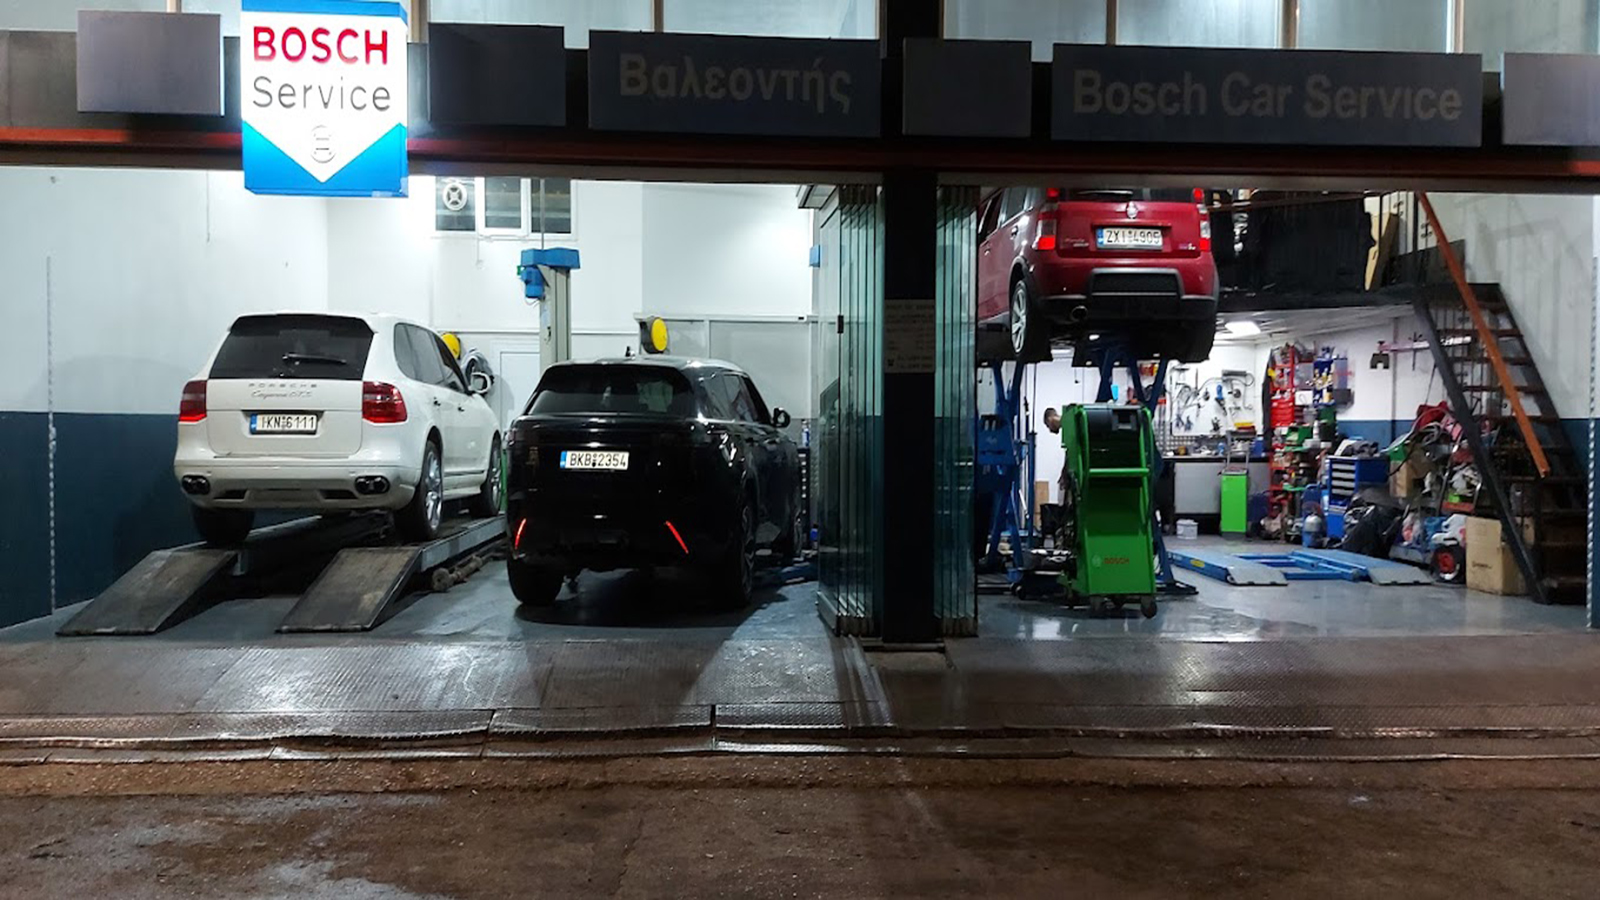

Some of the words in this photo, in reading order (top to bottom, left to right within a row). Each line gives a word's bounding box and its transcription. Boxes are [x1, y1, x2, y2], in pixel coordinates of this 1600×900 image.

[253, 26, 388, 65] BOSCH
[252, 76, 391, 111] Service
[619, 53, 851, 114] Βαλεοντής
[1072, 69, 1207, 116] Bosch
[1220, 71, 1292, 118] Car
[1304, 73, 1463, 121] Service
